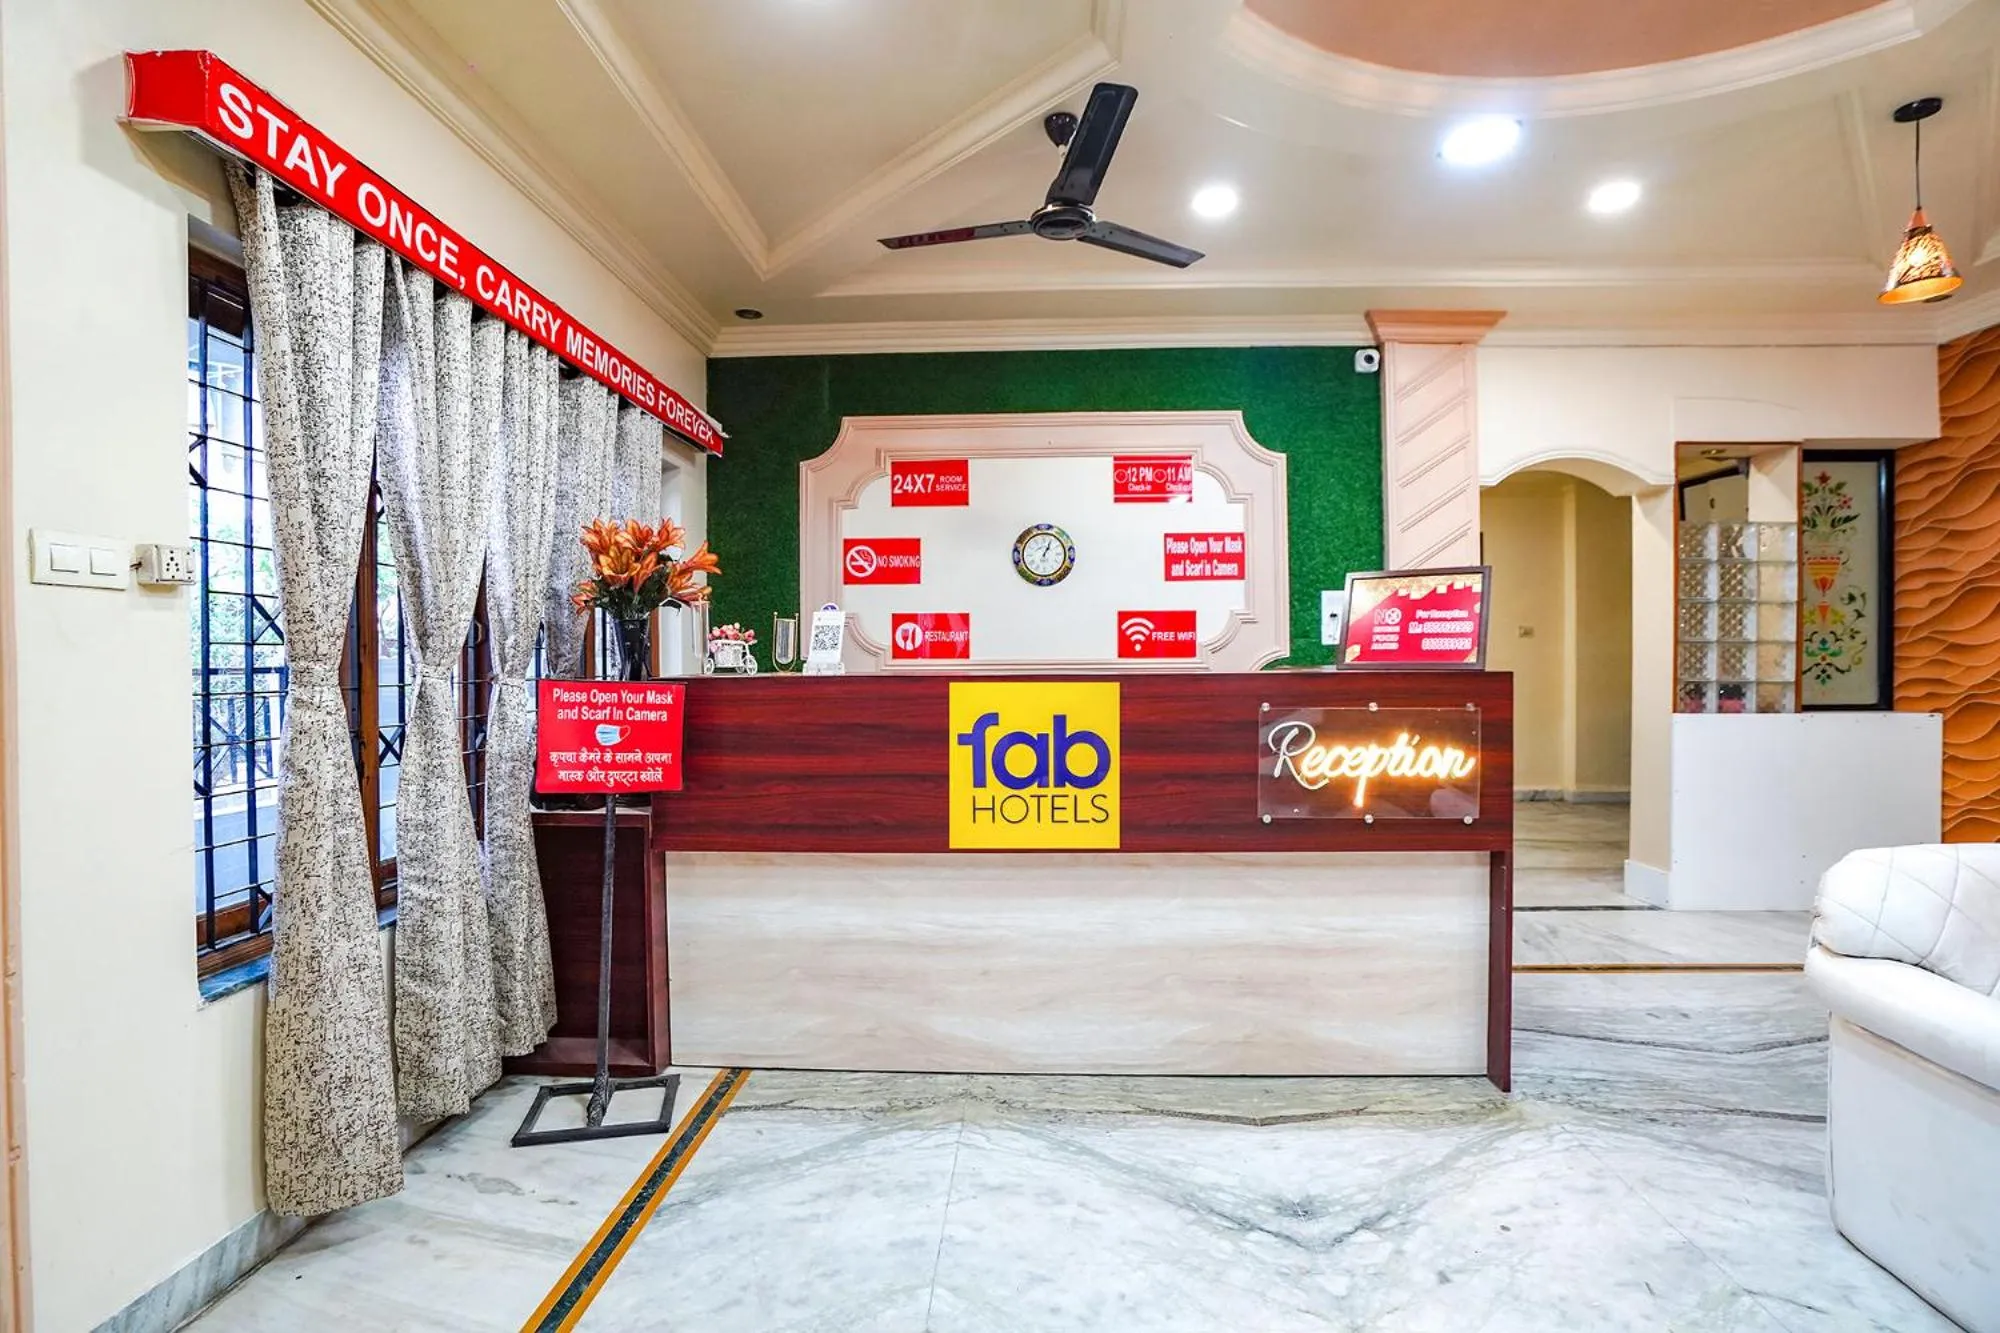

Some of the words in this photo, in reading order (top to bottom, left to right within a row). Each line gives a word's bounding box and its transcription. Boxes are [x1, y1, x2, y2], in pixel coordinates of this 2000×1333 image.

[218, 83, 347, 198] STAY
[357, 182, 466, 288] ONCE,
[475, 265, 562, 344] CARRY
[566, 325, 655, 406] MEMORIES
[939, 475, 963, 484] ROOM
[1127, 466, 1137, 482] 12
[1139, 466, 1153, 482] PM
[1167, 466, 1176, 482] 11
[1177, 466, 1192, 482] AM
[893, 473, 935, 494] 24X7
[935, 484, 968, 492] SERVICE
[1166, 537, 1188, 554] Please
[1190, 536, 1208, 556] Open
[1208, 536, 1224, 554] Your
[1224, 536, 1243, 554] Mask
[877, 555, 888, 568] NO
[889, 554, 921, 569] SMOKING
[1171, 560, 1184, 576] and
[1212, 558, 1238, 576] Camera
[925, 631, 969, 642] RESTAURANT
[1151, 631, 1175, 641] FREE
[552, 688, 587, 702] Please
[590, 689, 618, 706] Open
[620, 689, 644, 704] Your
[646, 690, 673, 704] Mask
[557, 706, 578, 720] and
[581, 706, 611, 720] Scarf
[626, 707, 667, 721] Camera
[603, 748, 613, 763] के
[957, 712, 1112, 788] fab
[1267, 720, 1476, 808] Reception
[557, 769, 585, 782] मास्क
[586, 765, 606, 782] और
[972, 793, 1110, 824] HOTELS
